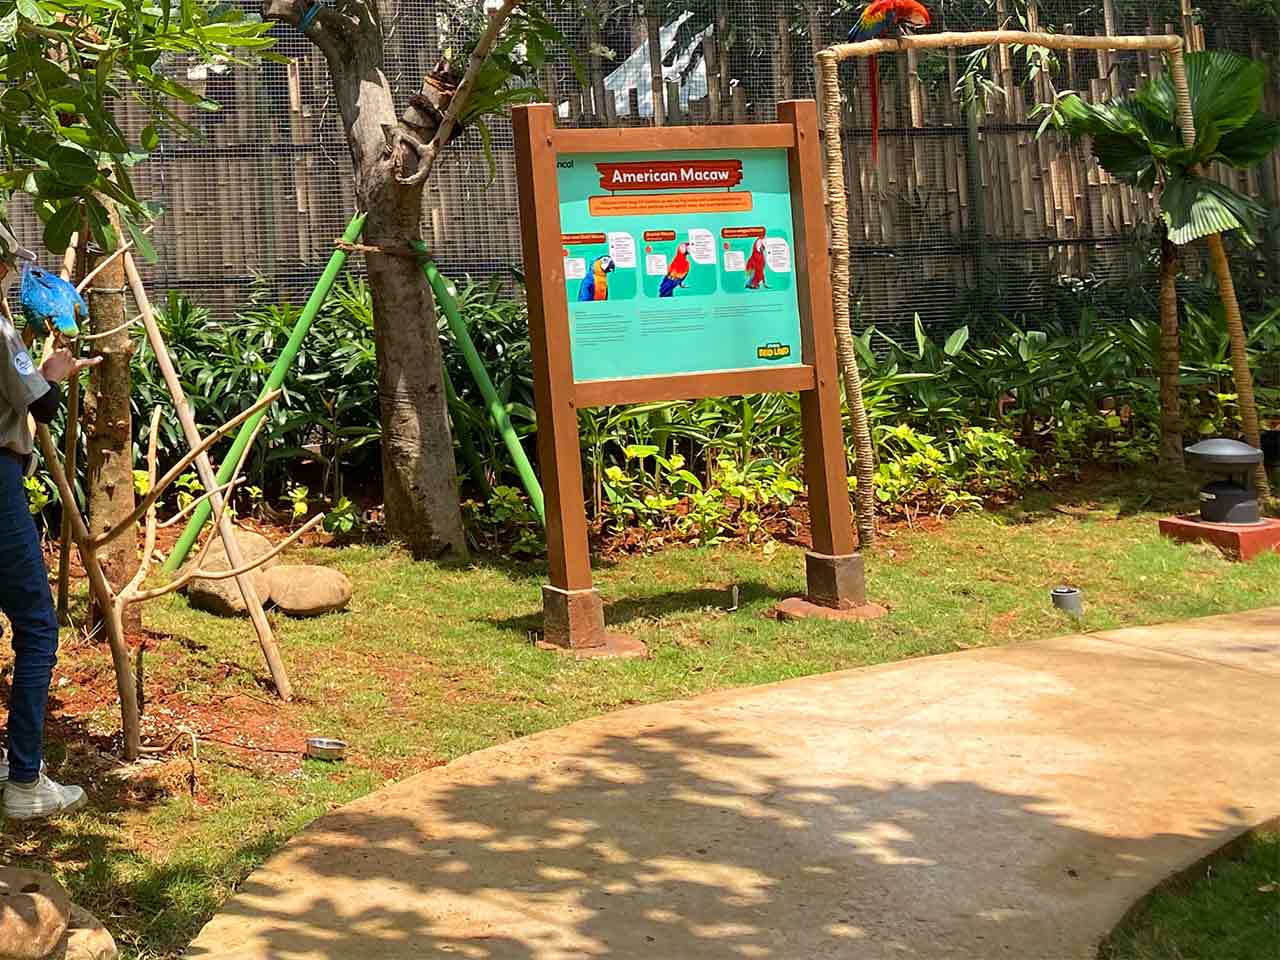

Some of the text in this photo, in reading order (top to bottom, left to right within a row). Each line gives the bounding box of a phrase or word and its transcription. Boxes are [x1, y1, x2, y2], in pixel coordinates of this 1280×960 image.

[556, 159, 574, 169] ncol
[612, 167, 729, 183] American Macaw
